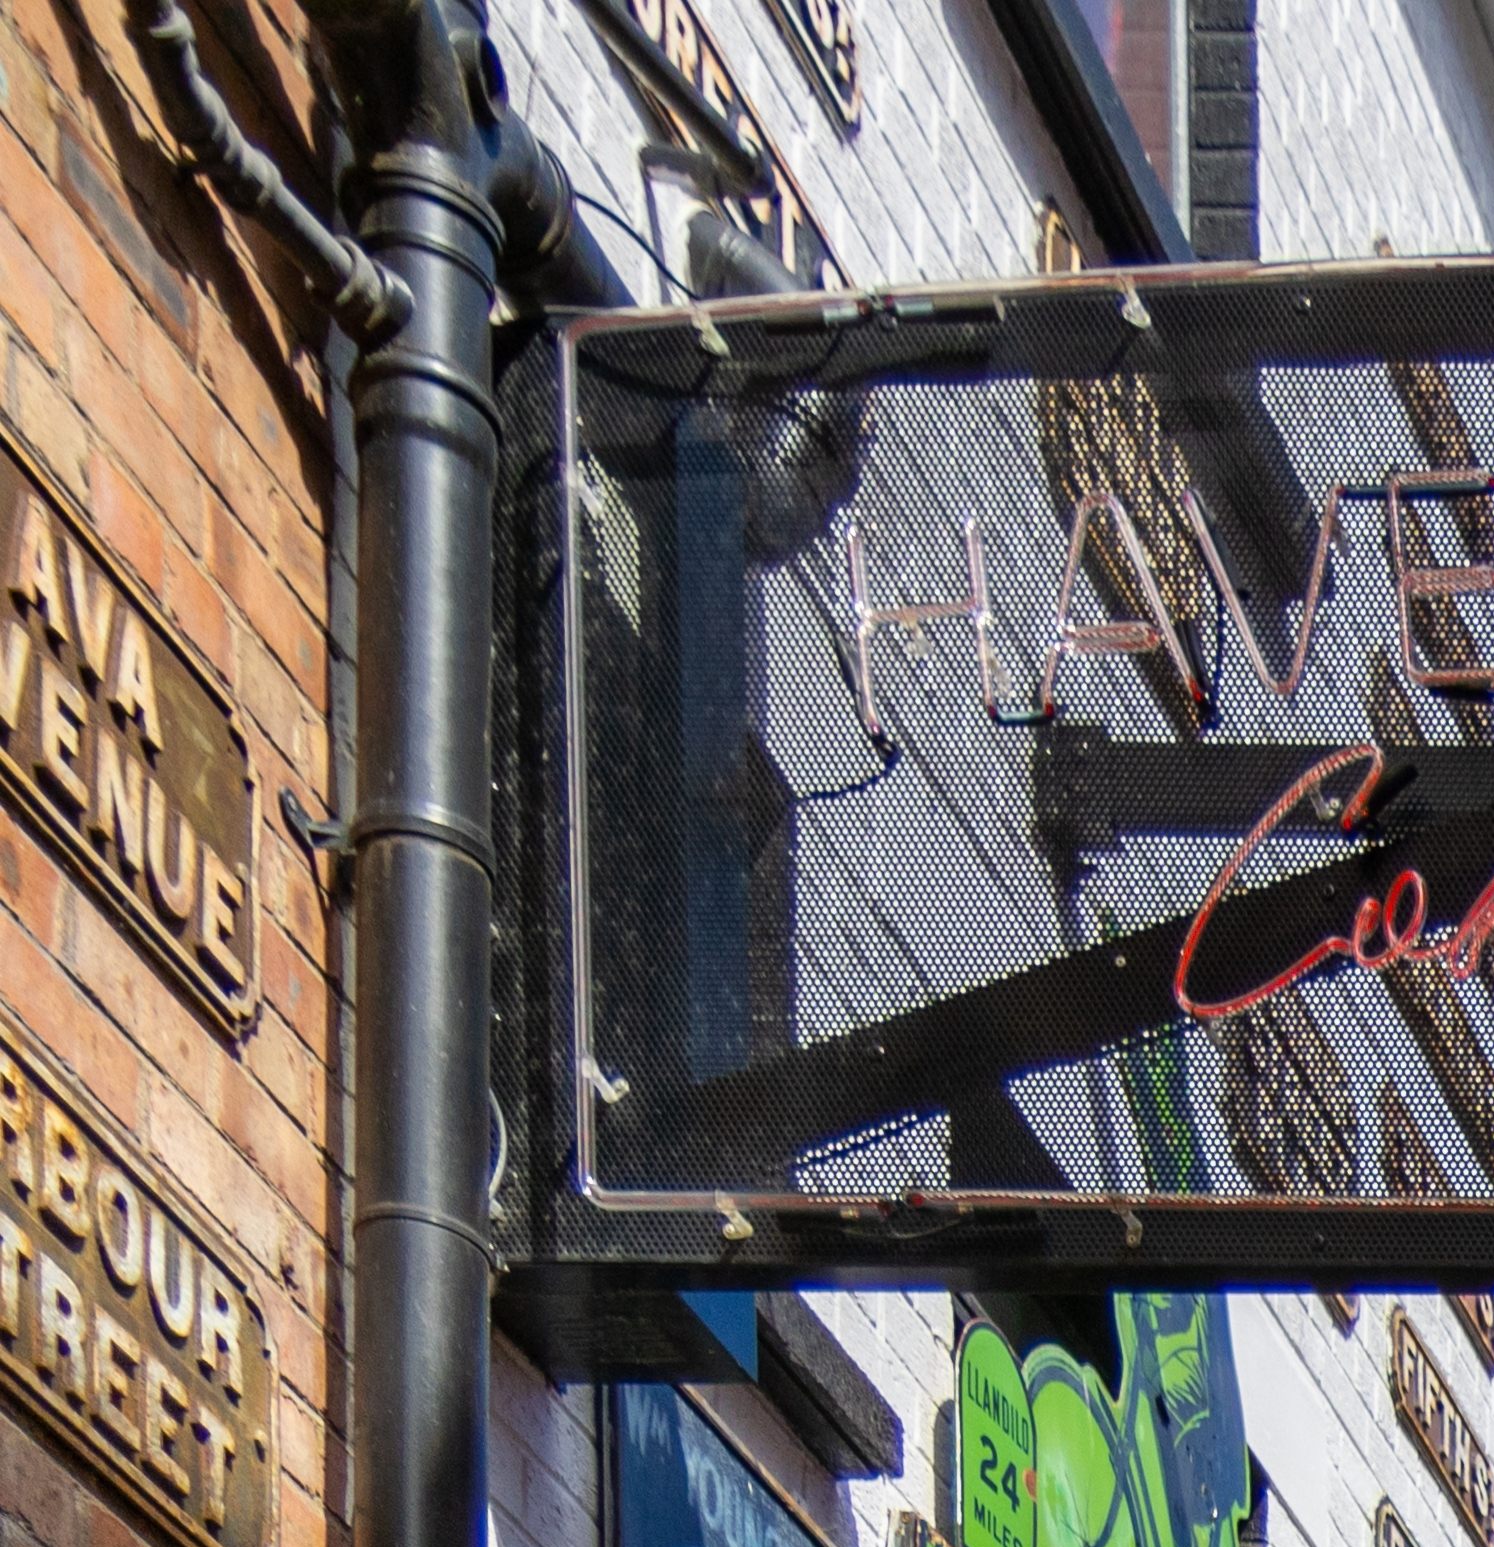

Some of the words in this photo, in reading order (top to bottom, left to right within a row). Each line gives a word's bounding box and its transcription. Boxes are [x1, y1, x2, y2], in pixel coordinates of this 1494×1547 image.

[16, 492, 163, 752] AVA
[979, 1434, 1020, 1514] 24
[1402, 1336, 1470, 1496] FIFTH
